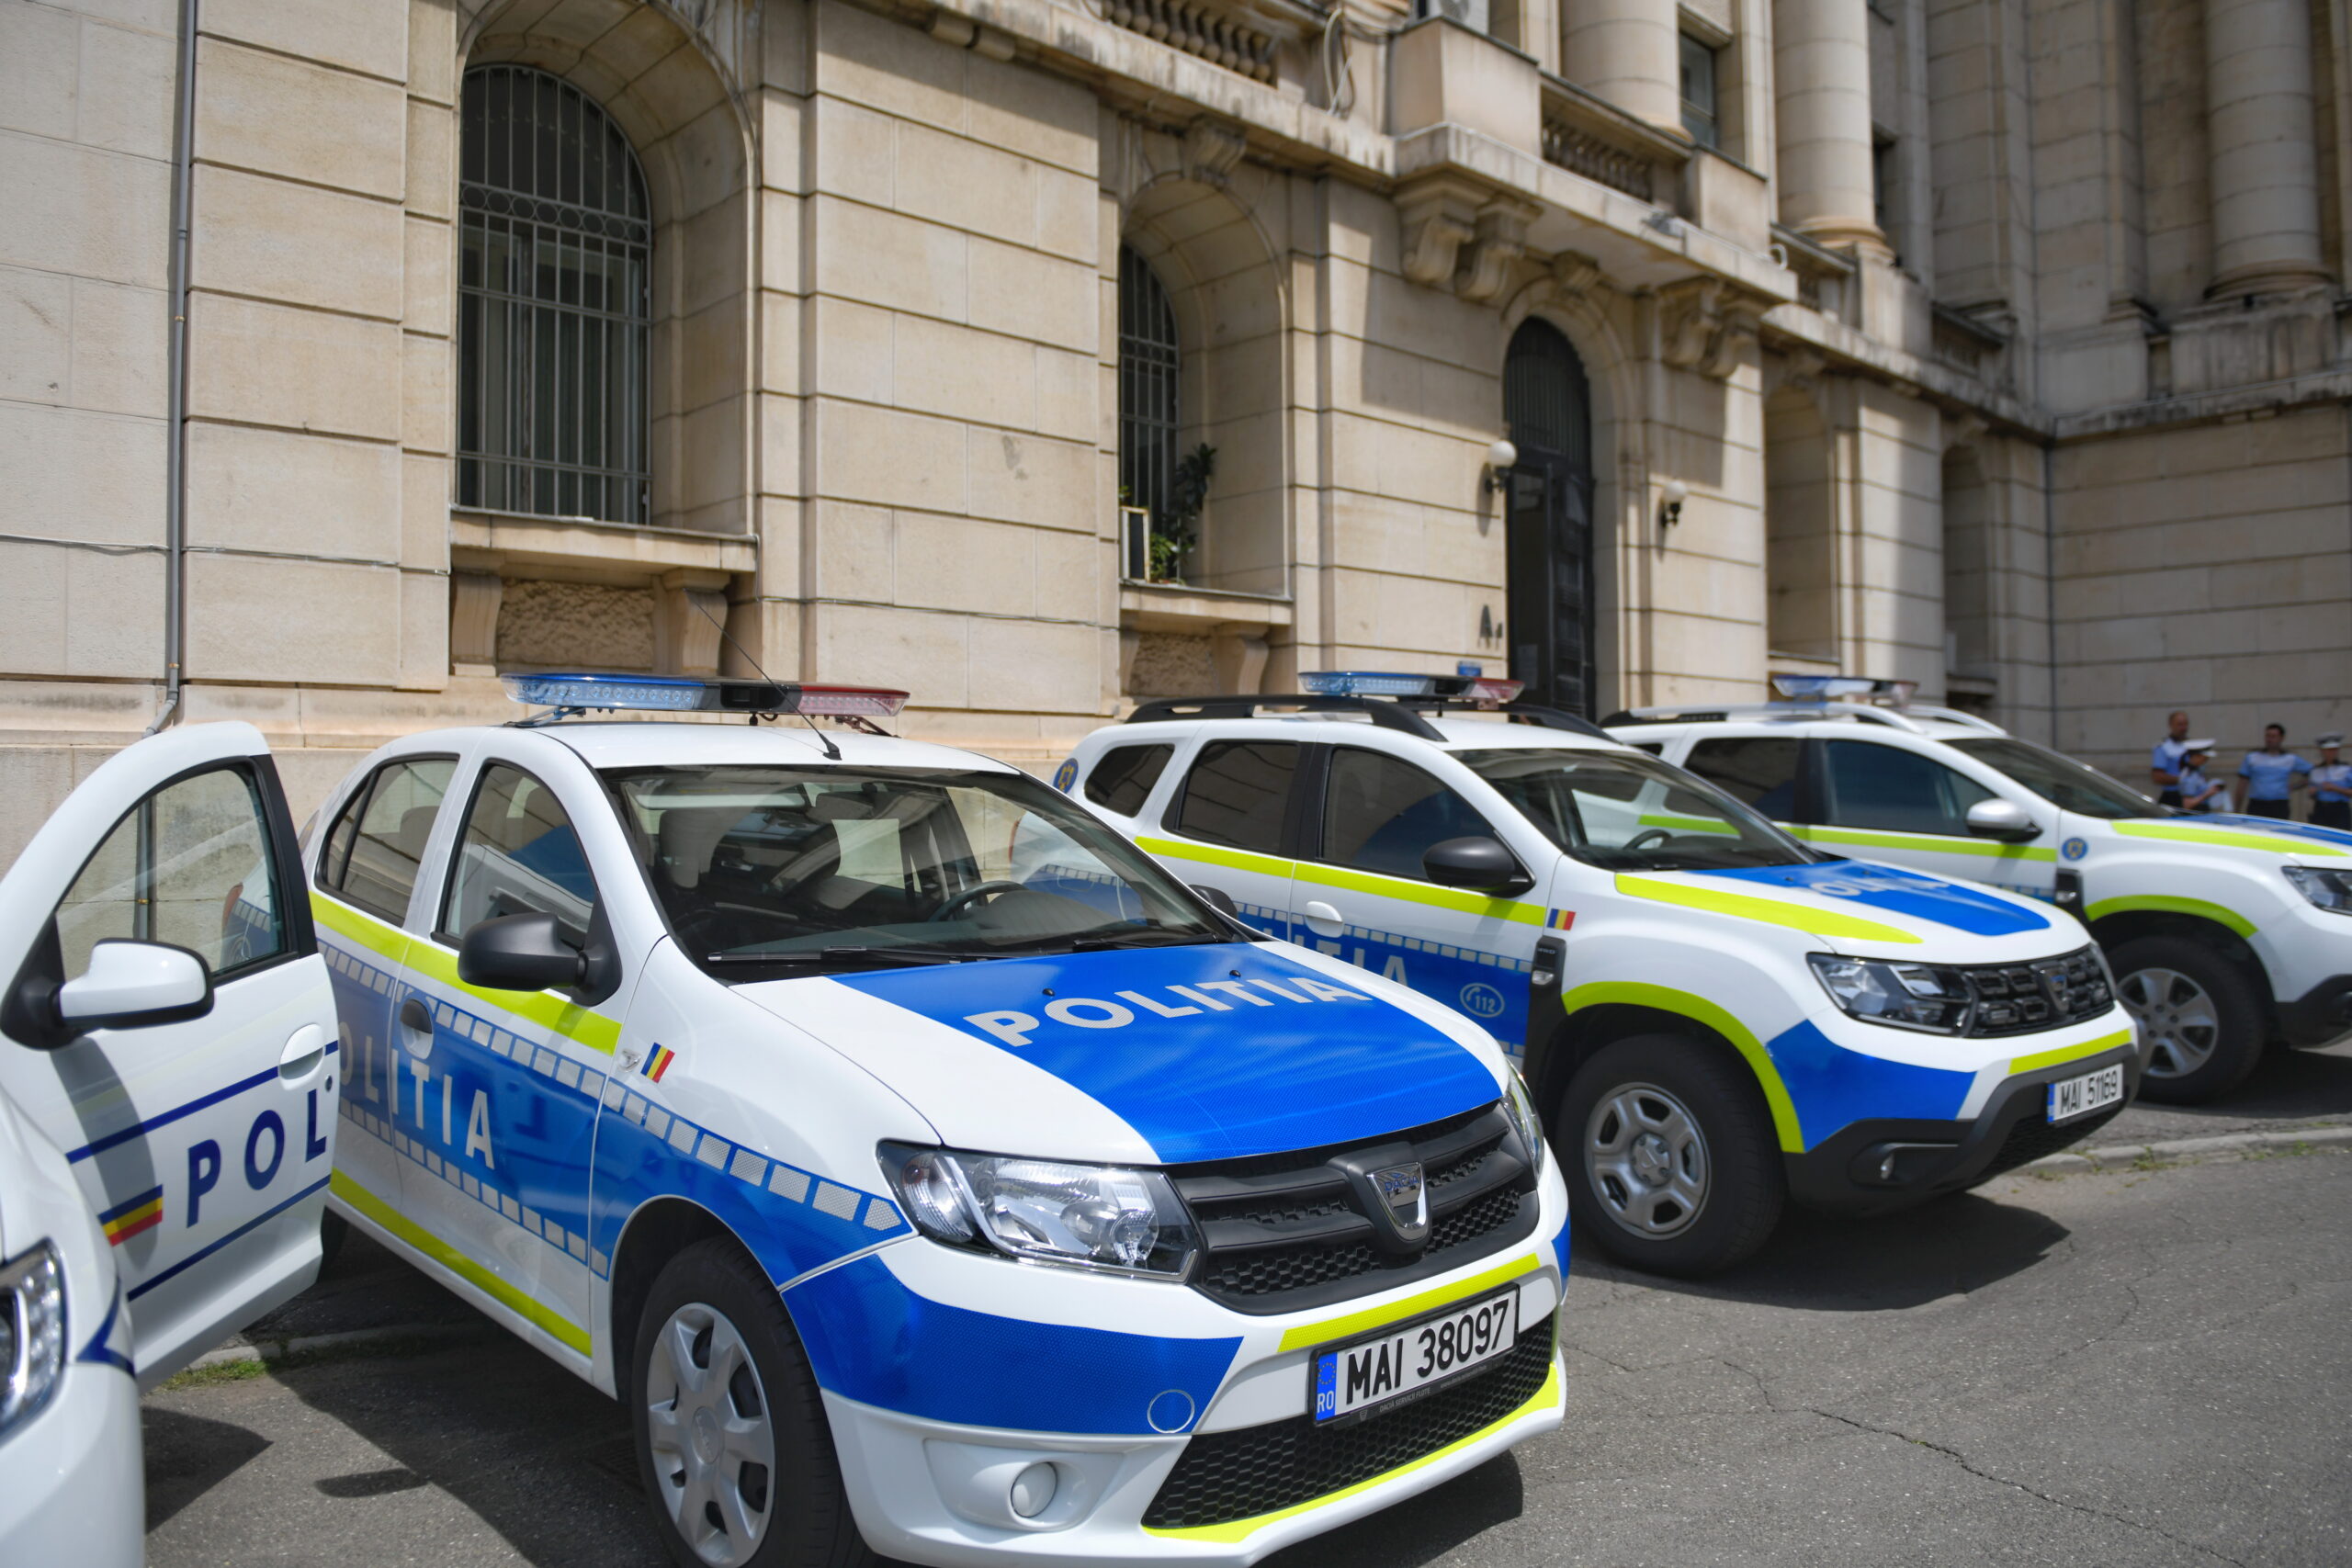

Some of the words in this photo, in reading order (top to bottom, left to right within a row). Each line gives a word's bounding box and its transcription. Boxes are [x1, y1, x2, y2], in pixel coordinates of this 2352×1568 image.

[963, 976, 1374, 1047] POLITIA
[1475, 995, 1496, 1013] 112
[340, 1021, 495, 1170] OLITIA
[2060, 1080, 2082, 1115] MAI
[1346, 1337, 1404, 1404] MAI
[1417, 1298, 1510, 1378] 38097
[1317, 1390, 1335, 1414] RO
